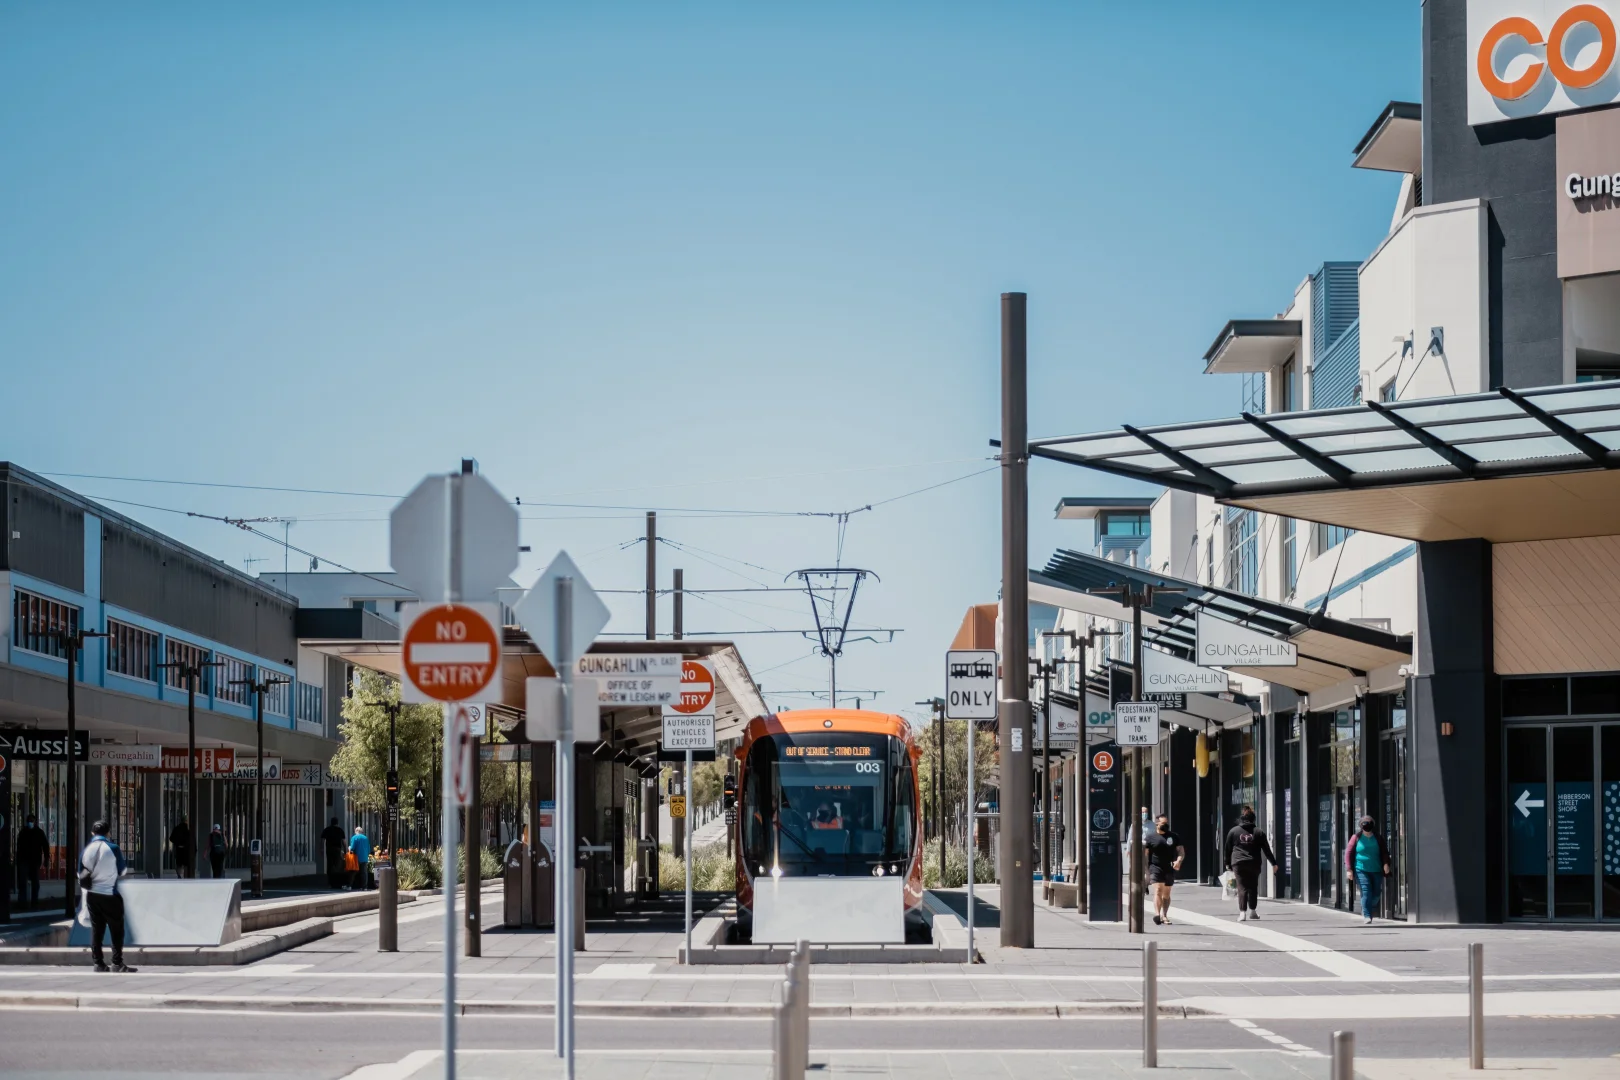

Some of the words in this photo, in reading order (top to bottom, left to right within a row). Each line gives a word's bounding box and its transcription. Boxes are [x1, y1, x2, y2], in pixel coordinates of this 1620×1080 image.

[435, 621, 467, 641] NO
[1204, 643, 1290, 656] GUNGAHLIN
[579, 658, 648, 673] GUNGAHLIN
[661, 658, 677, 666] EAST
[419, 666, 488, 686] ENTRY
[680, 670, 696, 680] NO
[1149, 674, 1223, 685] GUNGAHLIN
[607, 681, 637, 690] OFFICE
[641, 681, 653, 690] OF
[598, 692, 626, 702] DREW
[630, 692, 656, 702] LEIGH
[659, 692, 672, 701] MP
[680, 695, 707, 705] NTRY
[950, 691, 993, 706] ONLY
[1141, 693, 1182, 701] NYTIME
[1118, 706, 1157, 714] PEDESTRIANS
[1123, 715, 1136, 723] GIVE
[1138, 715, 1152, 723] WAY
[1128, 735, 1148, 743] TRAMS
[13, 736, 82, 755] Aussie
[806, 746, 829, 756] SERVICE
[91, 750, 105, 759] GP
[108, 750, 155, 761] Gungahlin
[204, 750, 212, 770] BOX
[855, 762, 880, 773] 003
